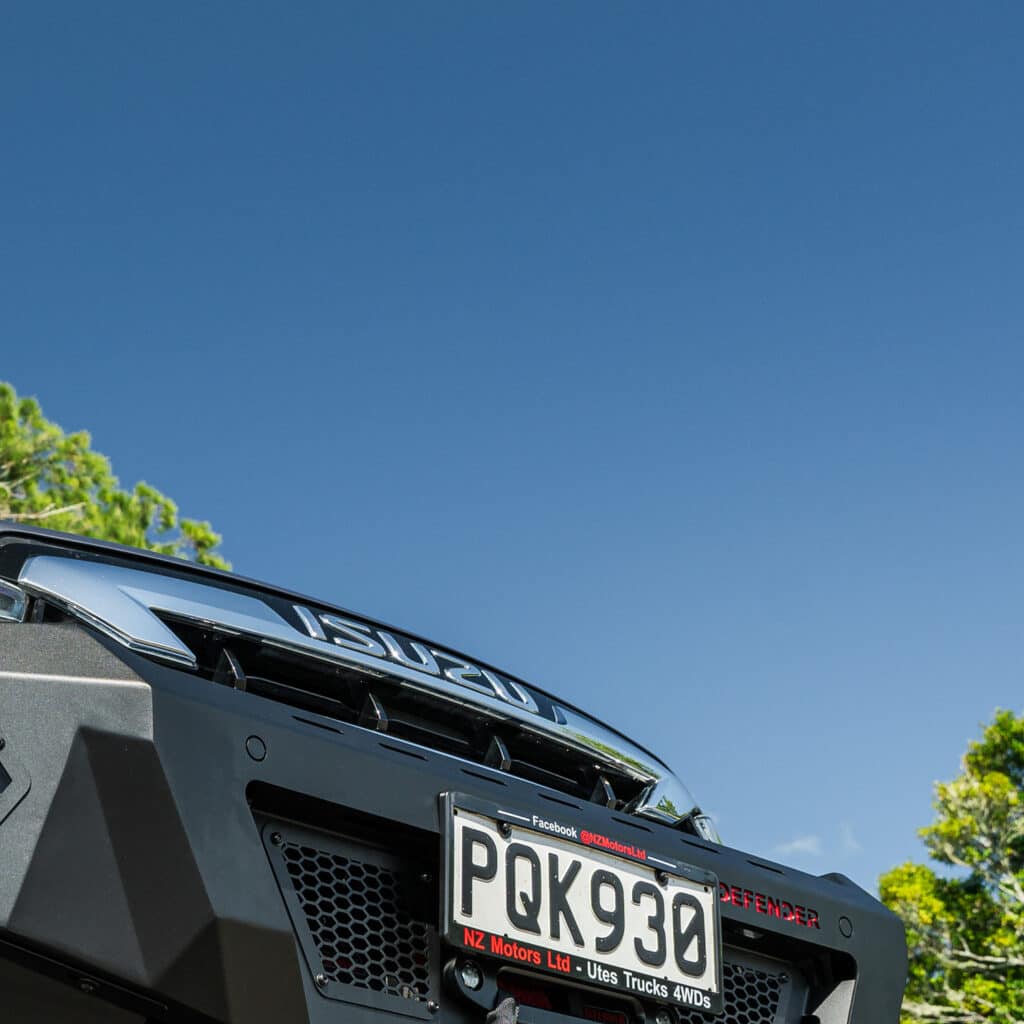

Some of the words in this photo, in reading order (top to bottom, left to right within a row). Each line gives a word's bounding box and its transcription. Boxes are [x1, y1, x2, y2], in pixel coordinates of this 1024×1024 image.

[292, 604, 540, 713] ISUZU
[532, 815, 578, 840] Facebook
[579, 829, 647, 861] @NZMotorsLtd
[461, 825, 708, 978] PQK930
[719, 880, 821, 930] DEFENDER
[463, 927, 486, 951] NZ
[490, 934, 542, 967] Motors
[546, 950, 571, 974] Ltd
[586, 960, 619, 986] Utes
[623, 971, 669, 999] Trucks
[673, 984, 712, 1010] 4WDs
